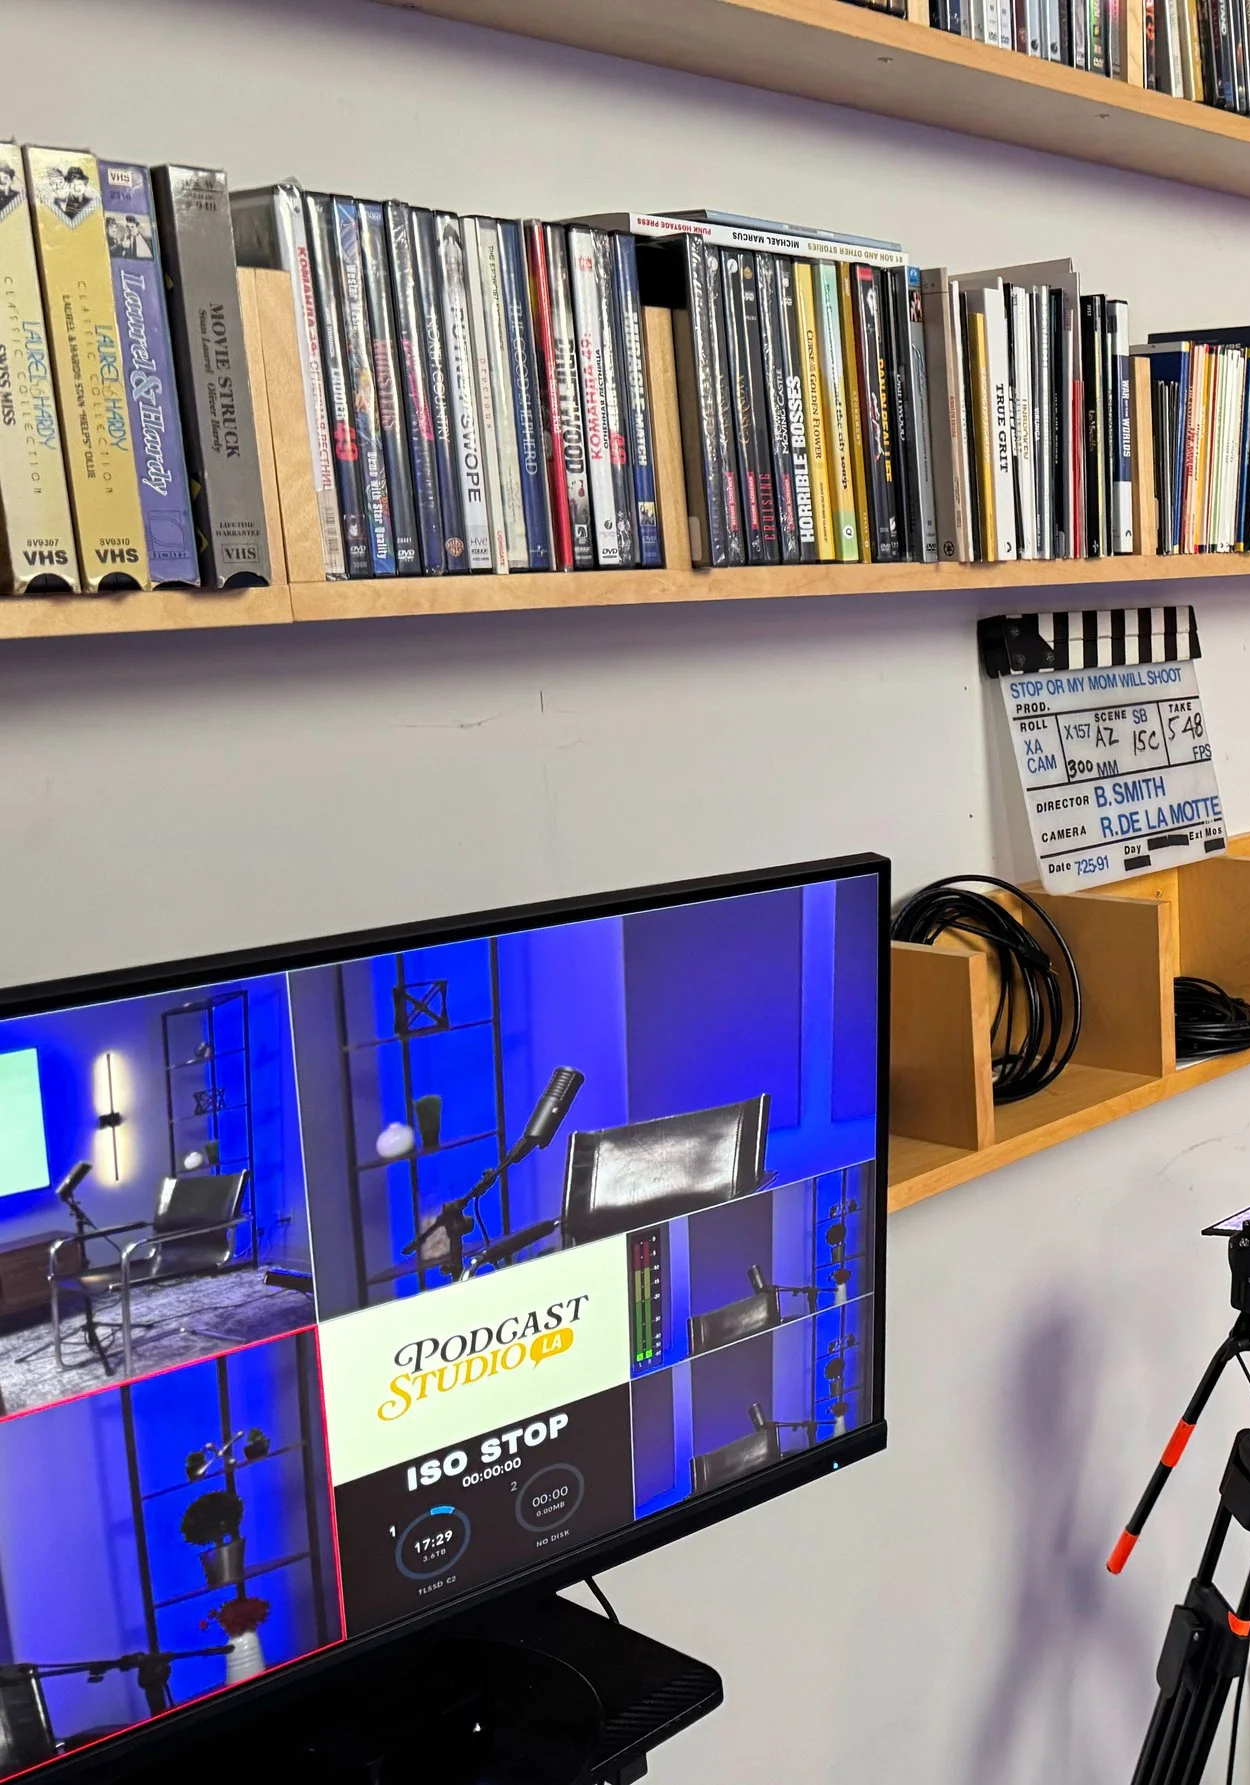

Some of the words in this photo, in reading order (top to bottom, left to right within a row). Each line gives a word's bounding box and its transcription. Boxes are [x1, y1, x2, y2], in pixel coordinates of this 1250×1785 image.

[110, 172, 130, 182] VHS
[637, 218, 659, 228] PRESS
[661, 222, 692, 233] HOSTAGE
[693, 227, 711, 236] PUNK
[732, 232, 764, 244] MARCUS
[766, 237, 800, 248] MICHAEL
[807, 242, 841, 255] STORIES
[842, 249, 862, 258] OTHER
[863, 252, 878, 261] AND
[879, 254, 892, 262] SON
[121, 270, 157, 371] Laurel
[198, 308, 208, 334] Stan
[209, 303, 230, 369] MOVIE
[805, 330, 816, 363] CURSE
[22, 321, 47, 384] LAUREL
[95, 325, 119, 386] LAUREL
[202, 337, 214, 374] Laurel
[512, 338, 530, 389] GOOD
[130, 369, 162, 405] &
[206, 382, 219, 417] Oliver
[774, 368, 785, 406] CASTLE
[809, 374, 822, 415] GOLDEN
[1121, 380, 1130, 399] WAR
[1, 391, 16, 426] MISS
[217, 376, 240, 458] STRUCK
[431, 371, 450, 442] COUNTRY
[554, 338, 585, 473] DRIFTWOOD
[786, 376, 806, 448] BOSSES
[836, 409, 844, 429] the
[996, 384, 1006, 426] TRUE
[34, 396, 56, 451] HARDY
[90, 374, 113, 495] COLLECTION
[106, 398, 128, 451] HARDY
[211, 418, 223, 454] Hardy
[518, 393, 538, 475] SHEPHERD
[553, 416, 562, 433] Kid
[780, 408, 789, 454] MOVING
[1033, 407, 1041, 442] VIRUNGA
[139, 402, 172, 496] Hardy
[334, 421, 359, 461] 49
[634, 413, 648, 466] MATCH
[812, 418, 824, 459] FLOWER
[838, 432, 846, 452] city
[999, 430, 1009, 472] GRIT
[1121, 418, 1131, 458] WORLDS
[460, 414, 482, 503] SWOPE
[841, 456, 849, 490] songs
[758, 473, 776, 540] CRUISING
[793, 454, 815, 543] HORRIBLE
[373, 504, 383, 524] Star
[23, 550, 68, 565] VHS
[95, 548, 139, 564] VHS
[224, 547, 257, 560] VHS
[375, 528, 388, 560] Quality
[1010, 682, 1043, 699] STOP
[1046, 679, 1064, 695] OR
[1068, 676, 1086, 693] MY
[1089, 673, 1118, 690] MOM
[1118, 671, 1147, 688] WILL
[1148, 667, 1182, 685] SHOOT
[1016, 702, 1050, 714] PROD.
[1094, 709, 1127, 723] SCENE
[1132, 708, 1148, 725] SB
[1169, 702, 1192, 713] TAKE
[1020, 719, 1048, 733] ROLL
[1064, 724, 1091, 741] X157
[1095, 726, 1119, 748] AZ
[1024, 738, 1043, 756] XA
[1193, 744, 1212, 760] FPS
[1027, 755, 1057, 774] CAM
[1068, 759, 1093, 778] 300
[1096, 760, 1119, 777] MM
[1036, 795, 1090, 813] DIRECTOR
[1042, 825, 1087, 843] CAMERA
[1146, 807, 1169, 831] LA
[1170, 795, 1222, 825] MOTTE
[1188, 828, 1203, 841] Ext
[1205, 826, 1223, 838] Mos
[1124, 844, 1141, 855] Day
[1048, 862, 1071, 874] Date
[394, 1295, 589, 1374] PODCAST
[377, 1343, 526, 1421] STUDIO
[542, 1337, 563, 1354] LA
[407, 1450, 468, 1491] ISO
[480, 1412, 569, 1464] STOP
[462, 1457, 522, 1488] 00:00:00
[510, 1481, 518, 1492] 2
[532, 1485, 569, 1507] 00:00
[536, 1501, 565, 1517] 0.00MB
[389, 1525, 397, 1538] 1
[414, 1529, 453, 1554] 17:29
[536, 1537, 549, 1548] NO
[551, 1529, 571, 1543] DISK
[422, 1549, 446, 1562] 3.6TB
[446, 1576, 457, 1586] C2
